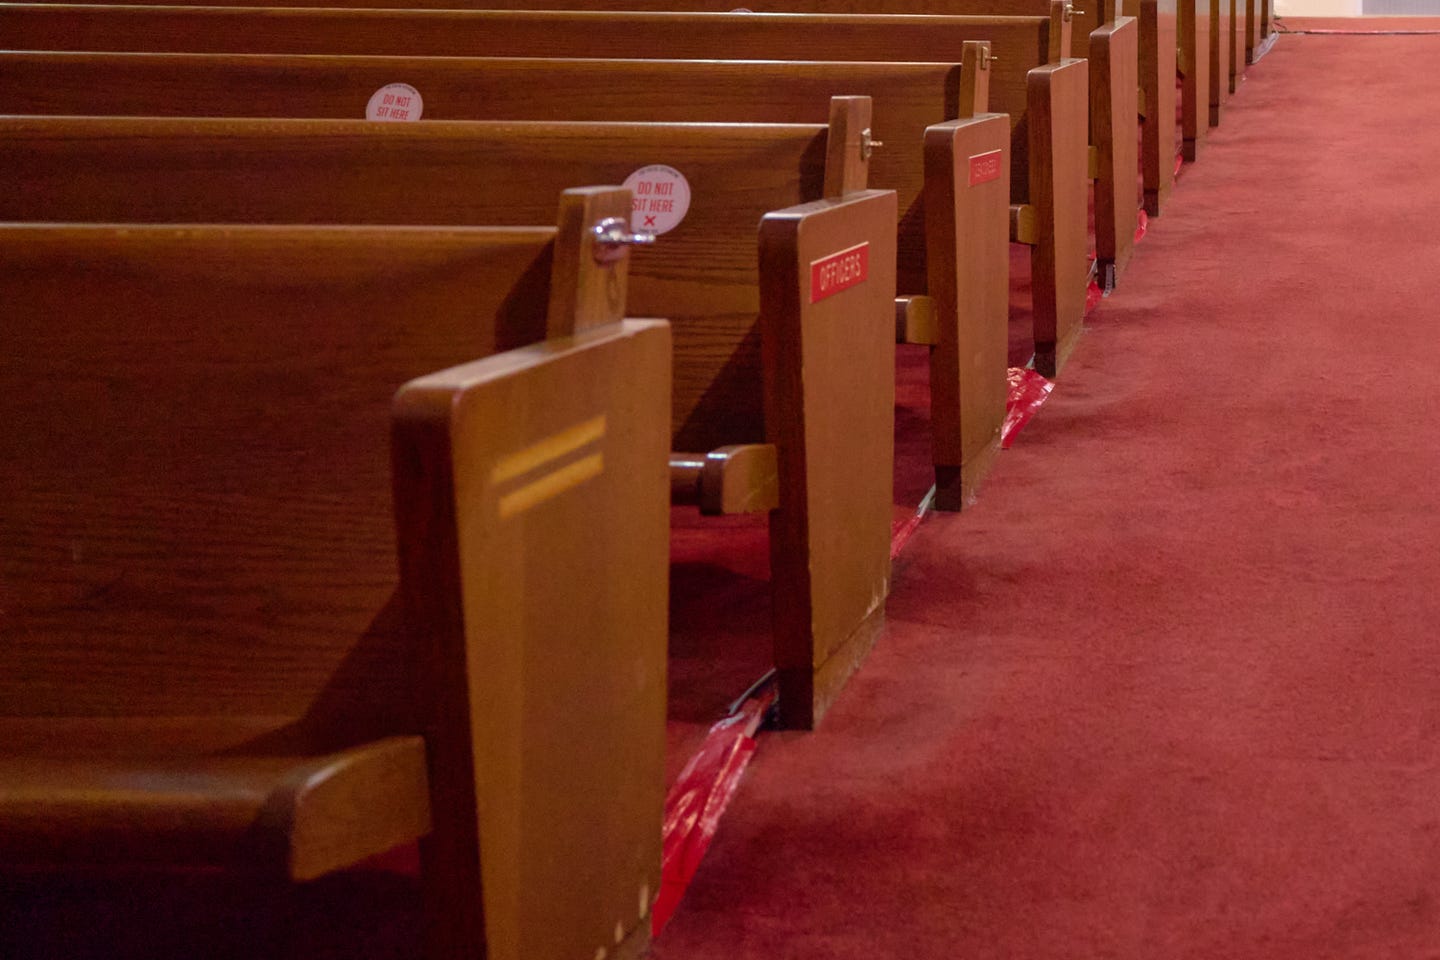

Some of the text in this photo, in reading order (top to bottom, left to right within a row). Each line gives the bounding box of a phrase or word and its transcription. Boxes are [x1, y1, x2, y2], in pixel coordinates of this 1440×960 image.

[383, 93, 411, 108] DO NOT
[376, 106, 409, 121] SIT HERE
[637, 181, 674, 196] DO NOT
[631, 198, 674, 213] SIT HERE
[819, 253, 861, 291] OFFICERS
